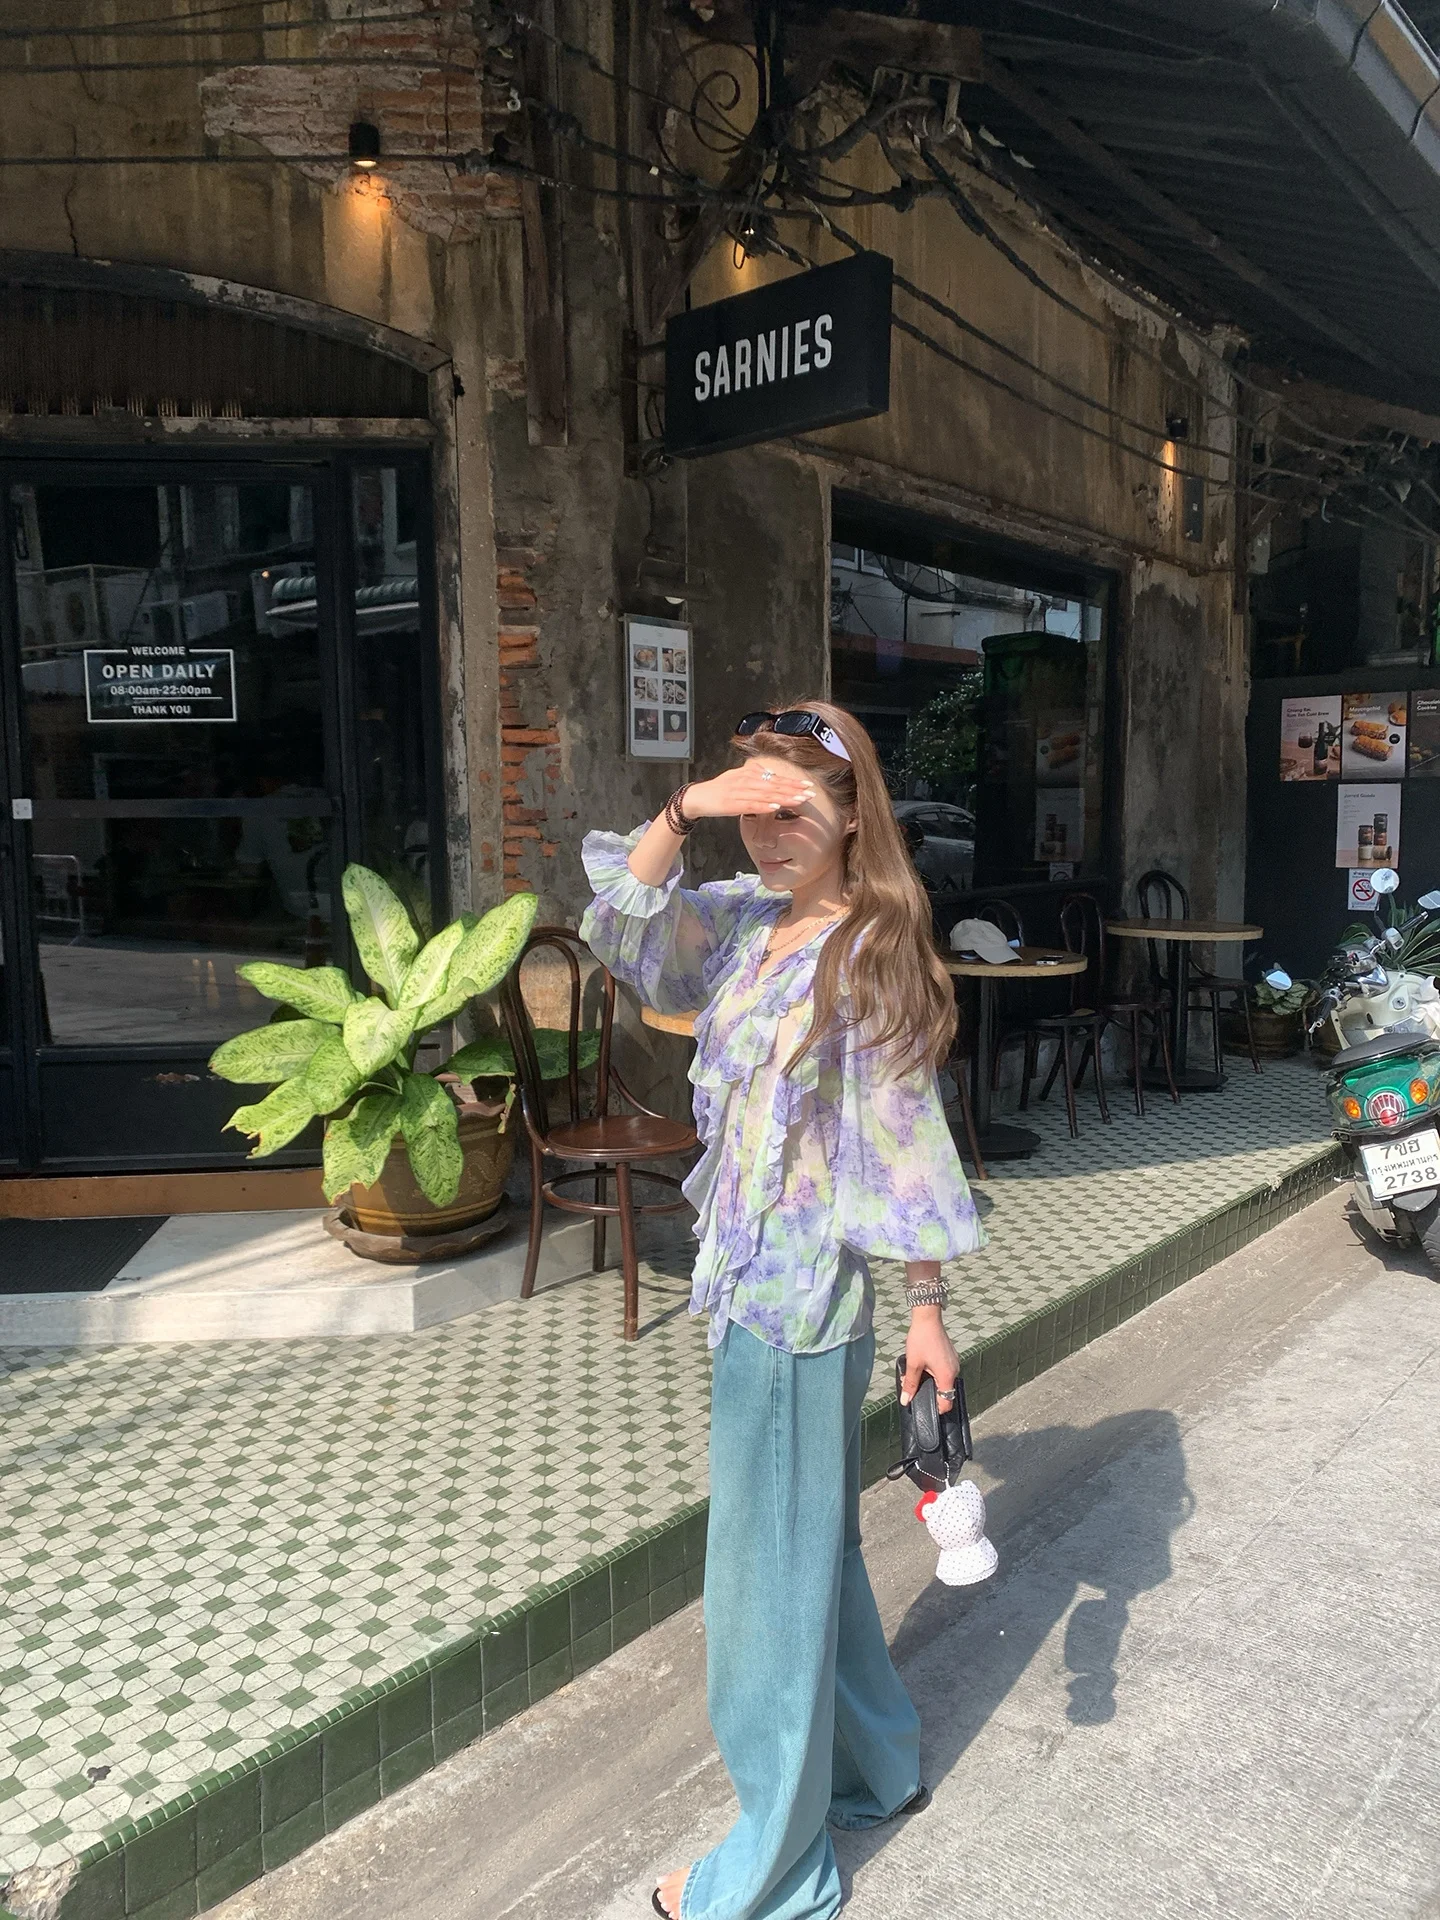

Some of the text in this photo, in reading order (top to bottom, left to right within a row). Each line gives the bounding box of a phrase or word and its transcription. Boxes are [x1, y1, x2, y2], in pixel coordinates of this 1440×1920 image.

[694, 313, 833, 402] SARNIES
[131, 646, 186, 656] WELCOME
[101, 663, 216, 679] OPEN DAILY
[110, 685, 212, 696] 08:00am-22:00pm
[131, 705, 191, 714] THANK YOU
[1371, 1153, 1439, 1176] กรุงเทพมหานคร
[1384, 1166, 1438, 1190] 2738
